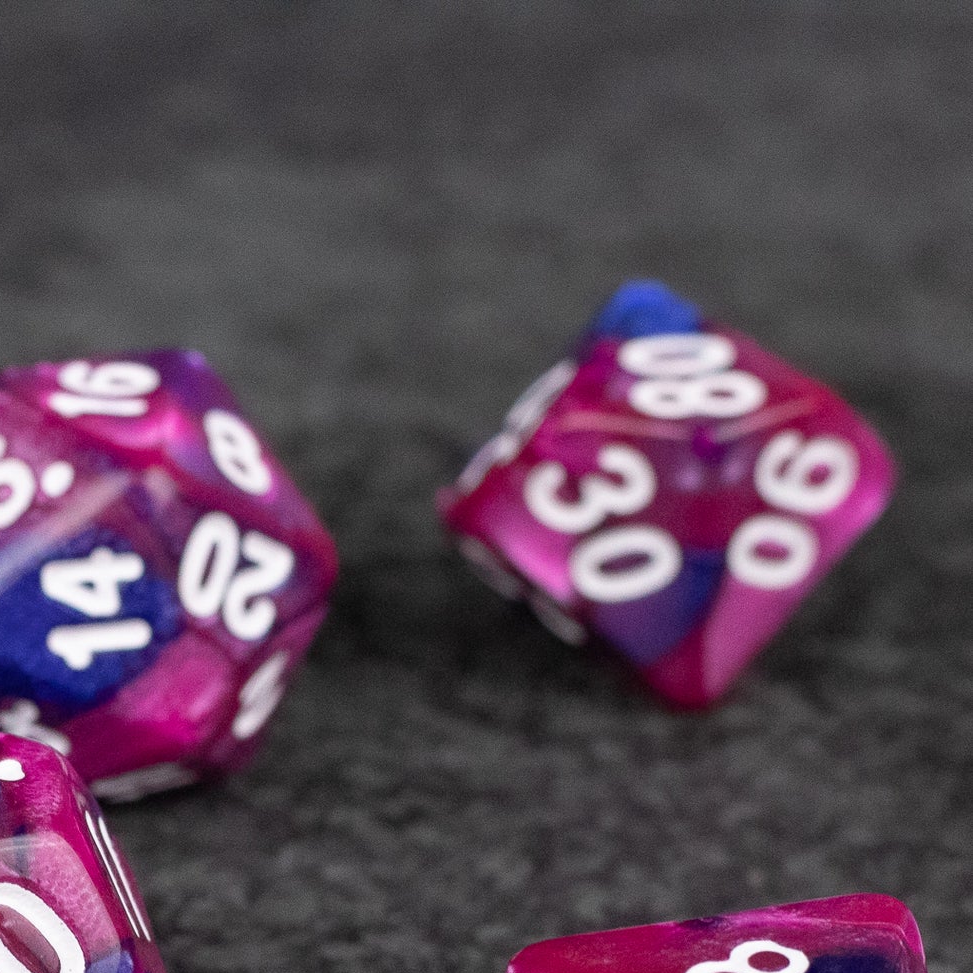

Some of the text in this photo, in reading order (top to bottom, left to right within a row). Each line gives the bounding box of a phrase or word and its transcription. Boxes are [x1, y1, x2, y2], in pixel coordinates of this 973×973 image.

[620, 334, 765, 419] 80
[204, 411, 272, 495] 8
[179, 514, 294, 640] 20
[525, 444, 683, 602] 30
[41, 547, 152, 670] 14
